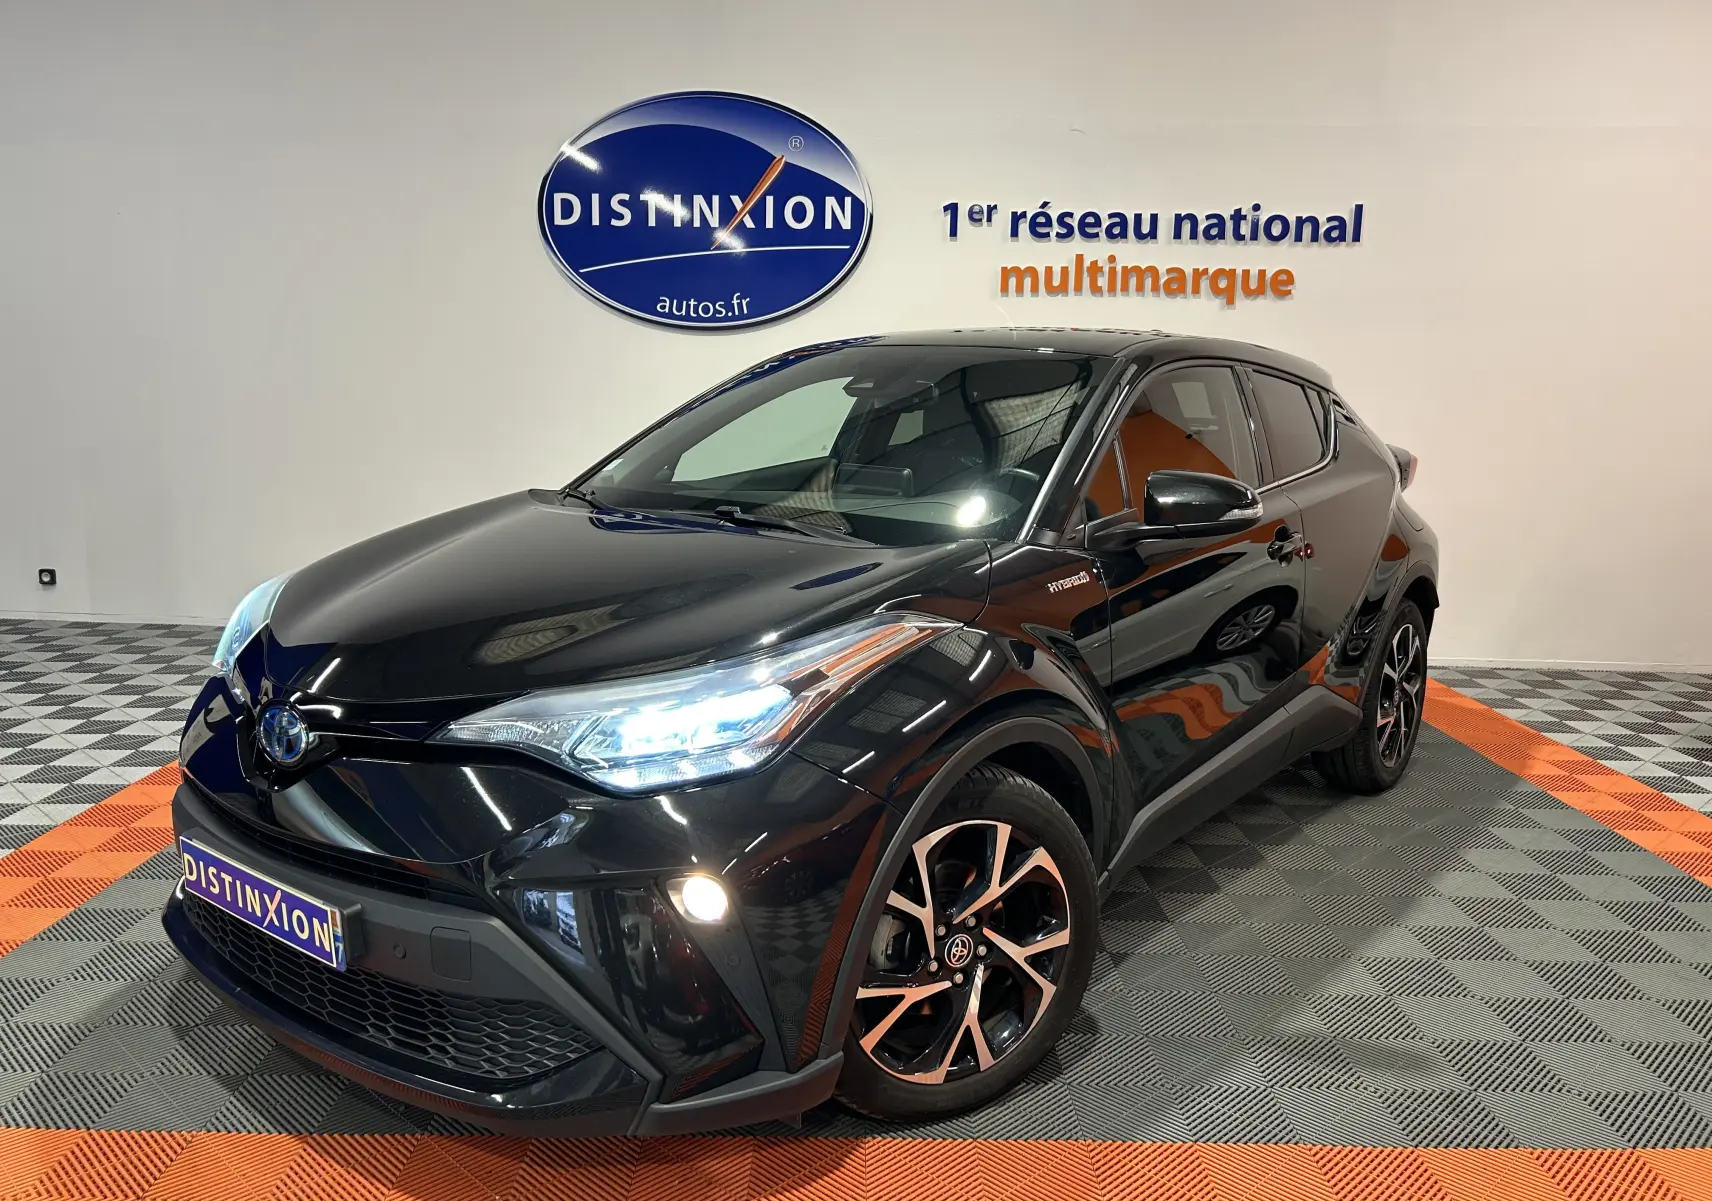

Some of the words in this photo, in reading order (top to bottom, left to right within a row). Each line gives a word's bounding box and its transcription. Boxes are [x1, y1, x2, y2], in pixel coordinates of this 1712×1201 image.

[553, 191, 852, 230] DISTINXION
[942, 202, 998, 238] 1er
[1009, 200, 1159, 241] réseau
[1172, 203, 1364, 243] national
[1000, 254, 1295, 305] multimarque
[656, 293, 750, 318] autos.fr
[183, 852, 331, 953] DISTINXION
